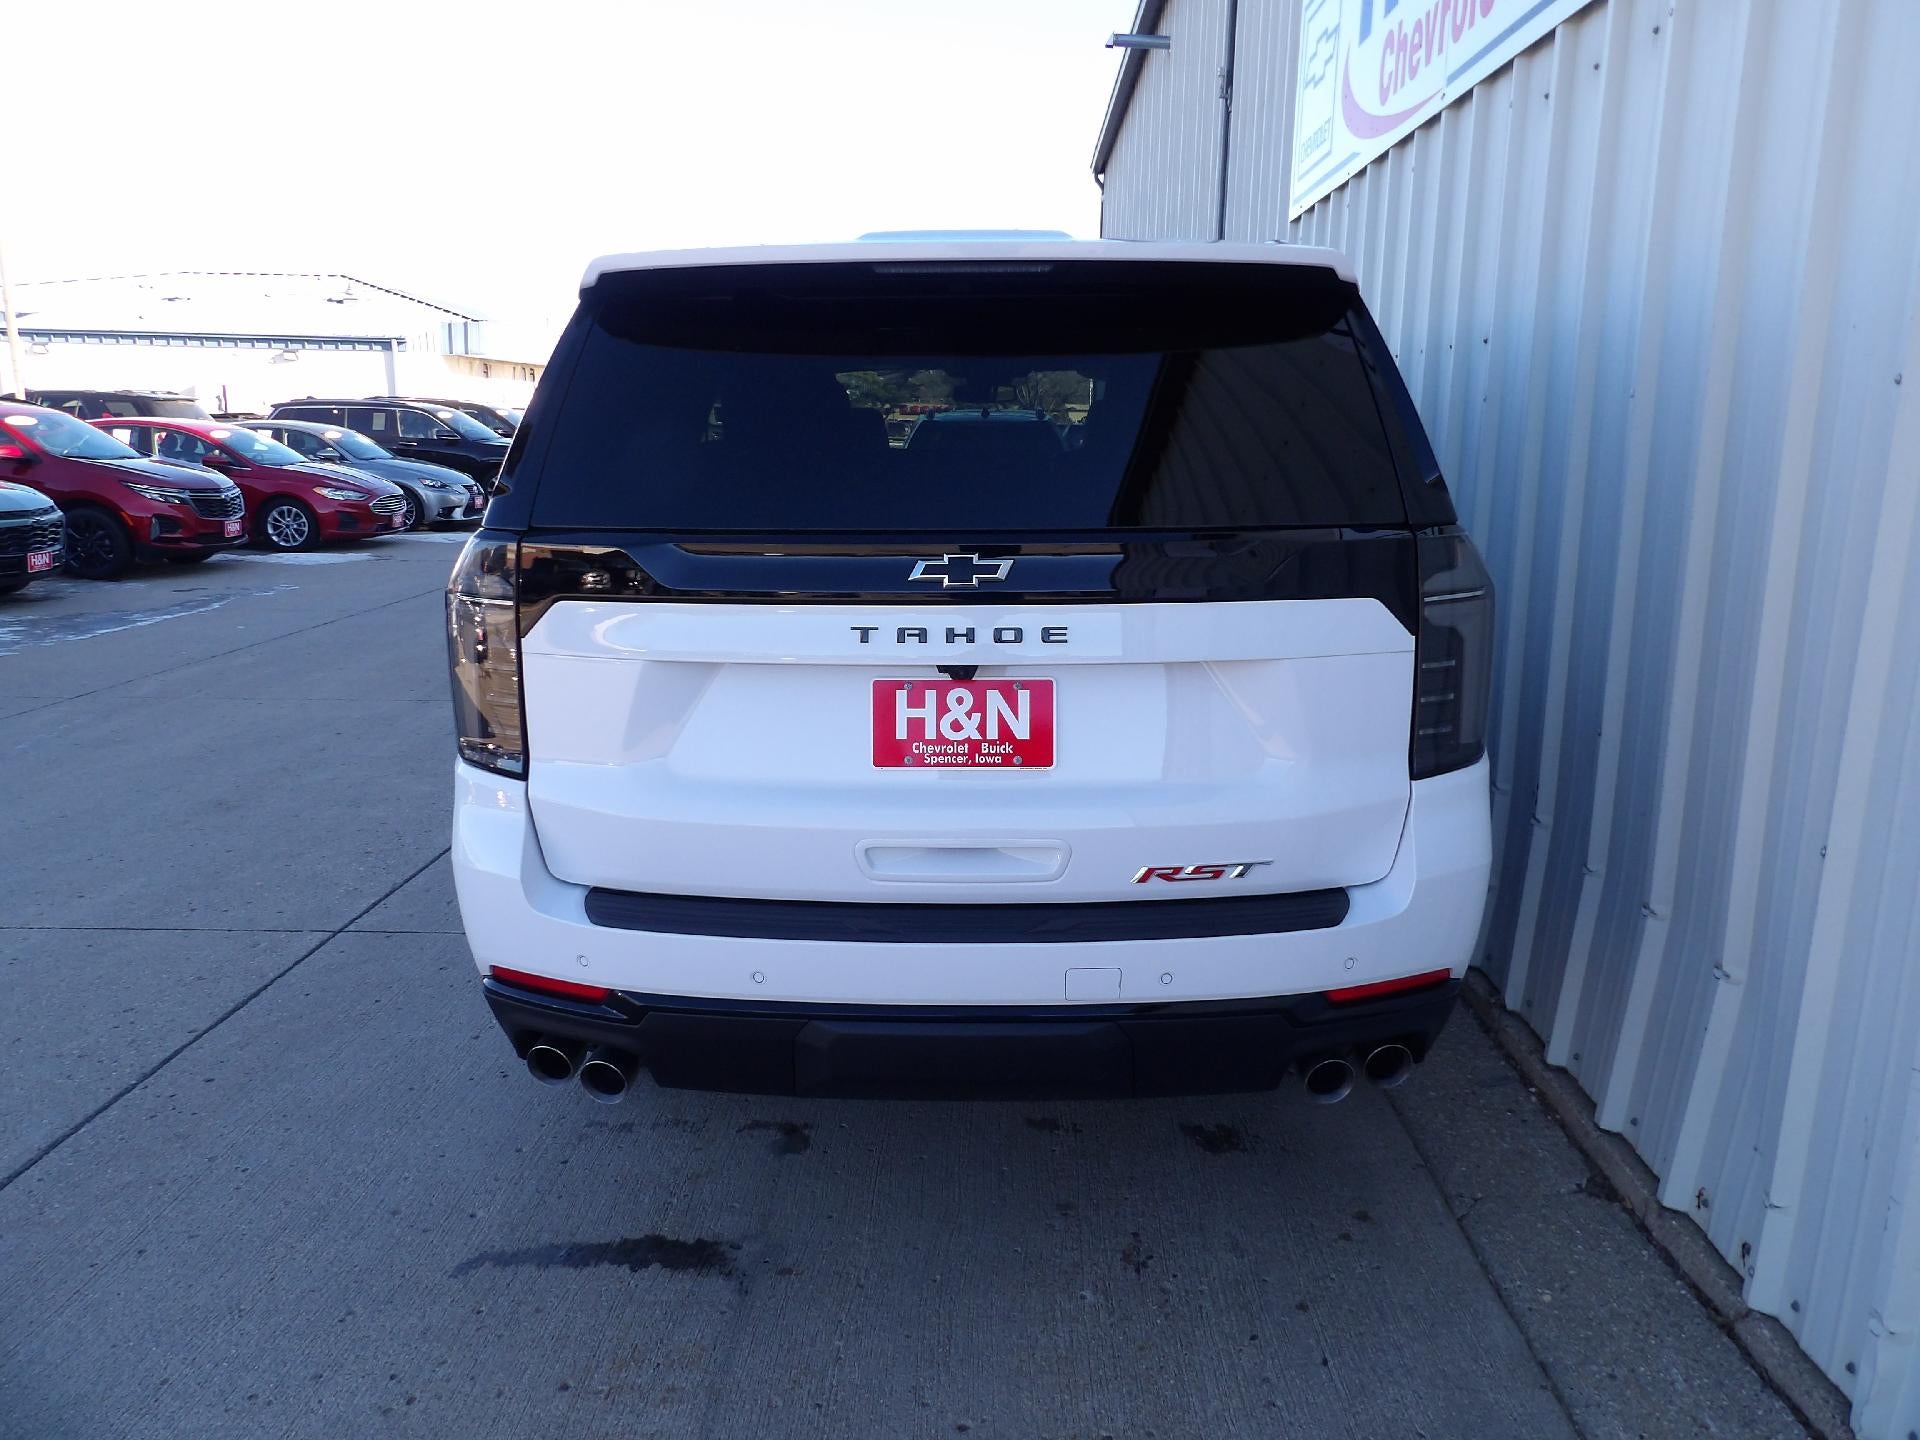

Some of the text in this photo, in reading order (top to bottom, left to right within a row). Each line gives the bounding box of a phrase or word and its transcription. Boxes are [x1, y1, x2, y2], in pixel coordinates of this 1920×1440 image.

[30, 552, 50, 566] H&N
[850, 626, 1068, 644] TAHOE
[895, 687, 1031, 741] H&N
[912, 740, 1014, 754] Chevrolet Buick
[923, 753, 1002, 765] Spencer, Iowa
[1130, 858, 1274, 884] RST
